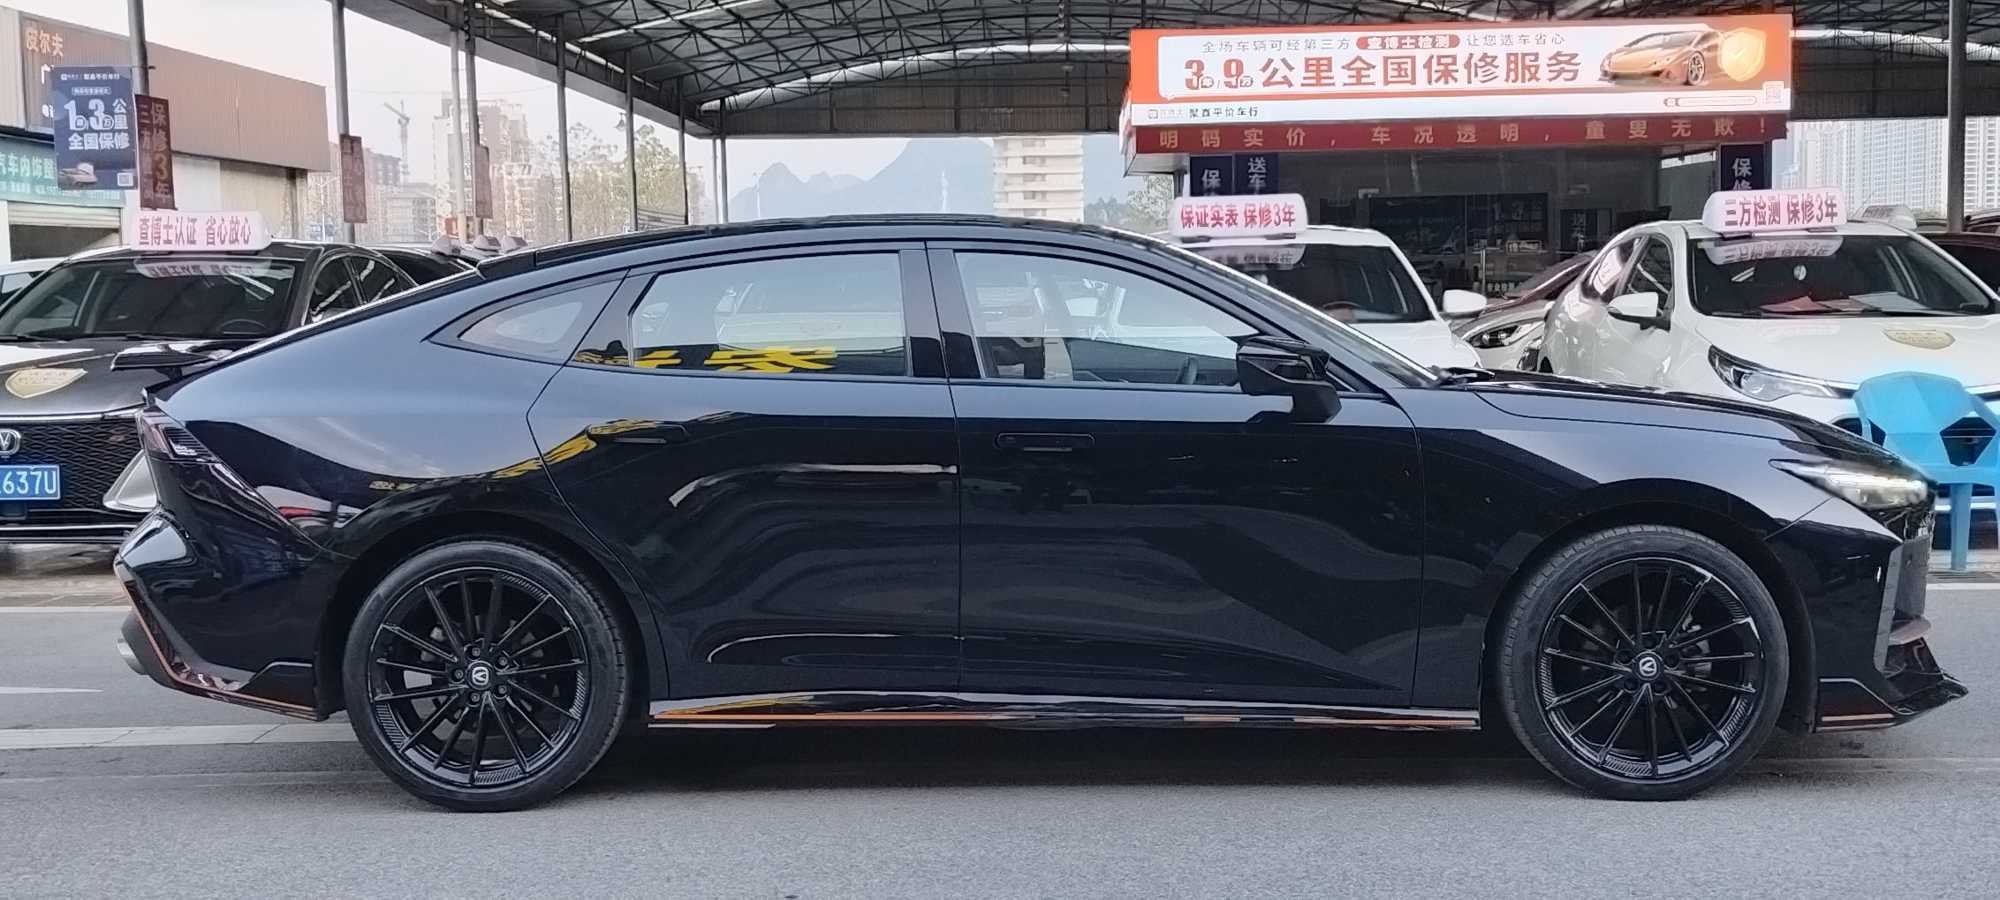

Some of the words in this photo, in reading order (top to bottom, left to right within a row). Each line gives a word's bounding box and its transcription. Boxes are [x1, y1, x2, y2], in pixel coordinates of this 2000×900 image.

[1202, 37, 1351, 54] 全场车辆可经第三方
[1367, 35, 1450, 50] 查博士检测
[1466, 33, 1565, 46] 让您选车省心
[68, 131, 130, 150] 全国保修
[152, 102, 171, 204] 保修3年
[1180, 203, 1239, 229] 保证实表
[1243, 203, 1296, 227] 保修3年
[1724, 194, 1781, 227] 三方检测
[1786, 193, 1838, 225] 保修3年
[138, 215, 197, 246] 查博士认证
[205, 215, 251, 246] 省心放心
[0, 470, 57, 495] 637U
